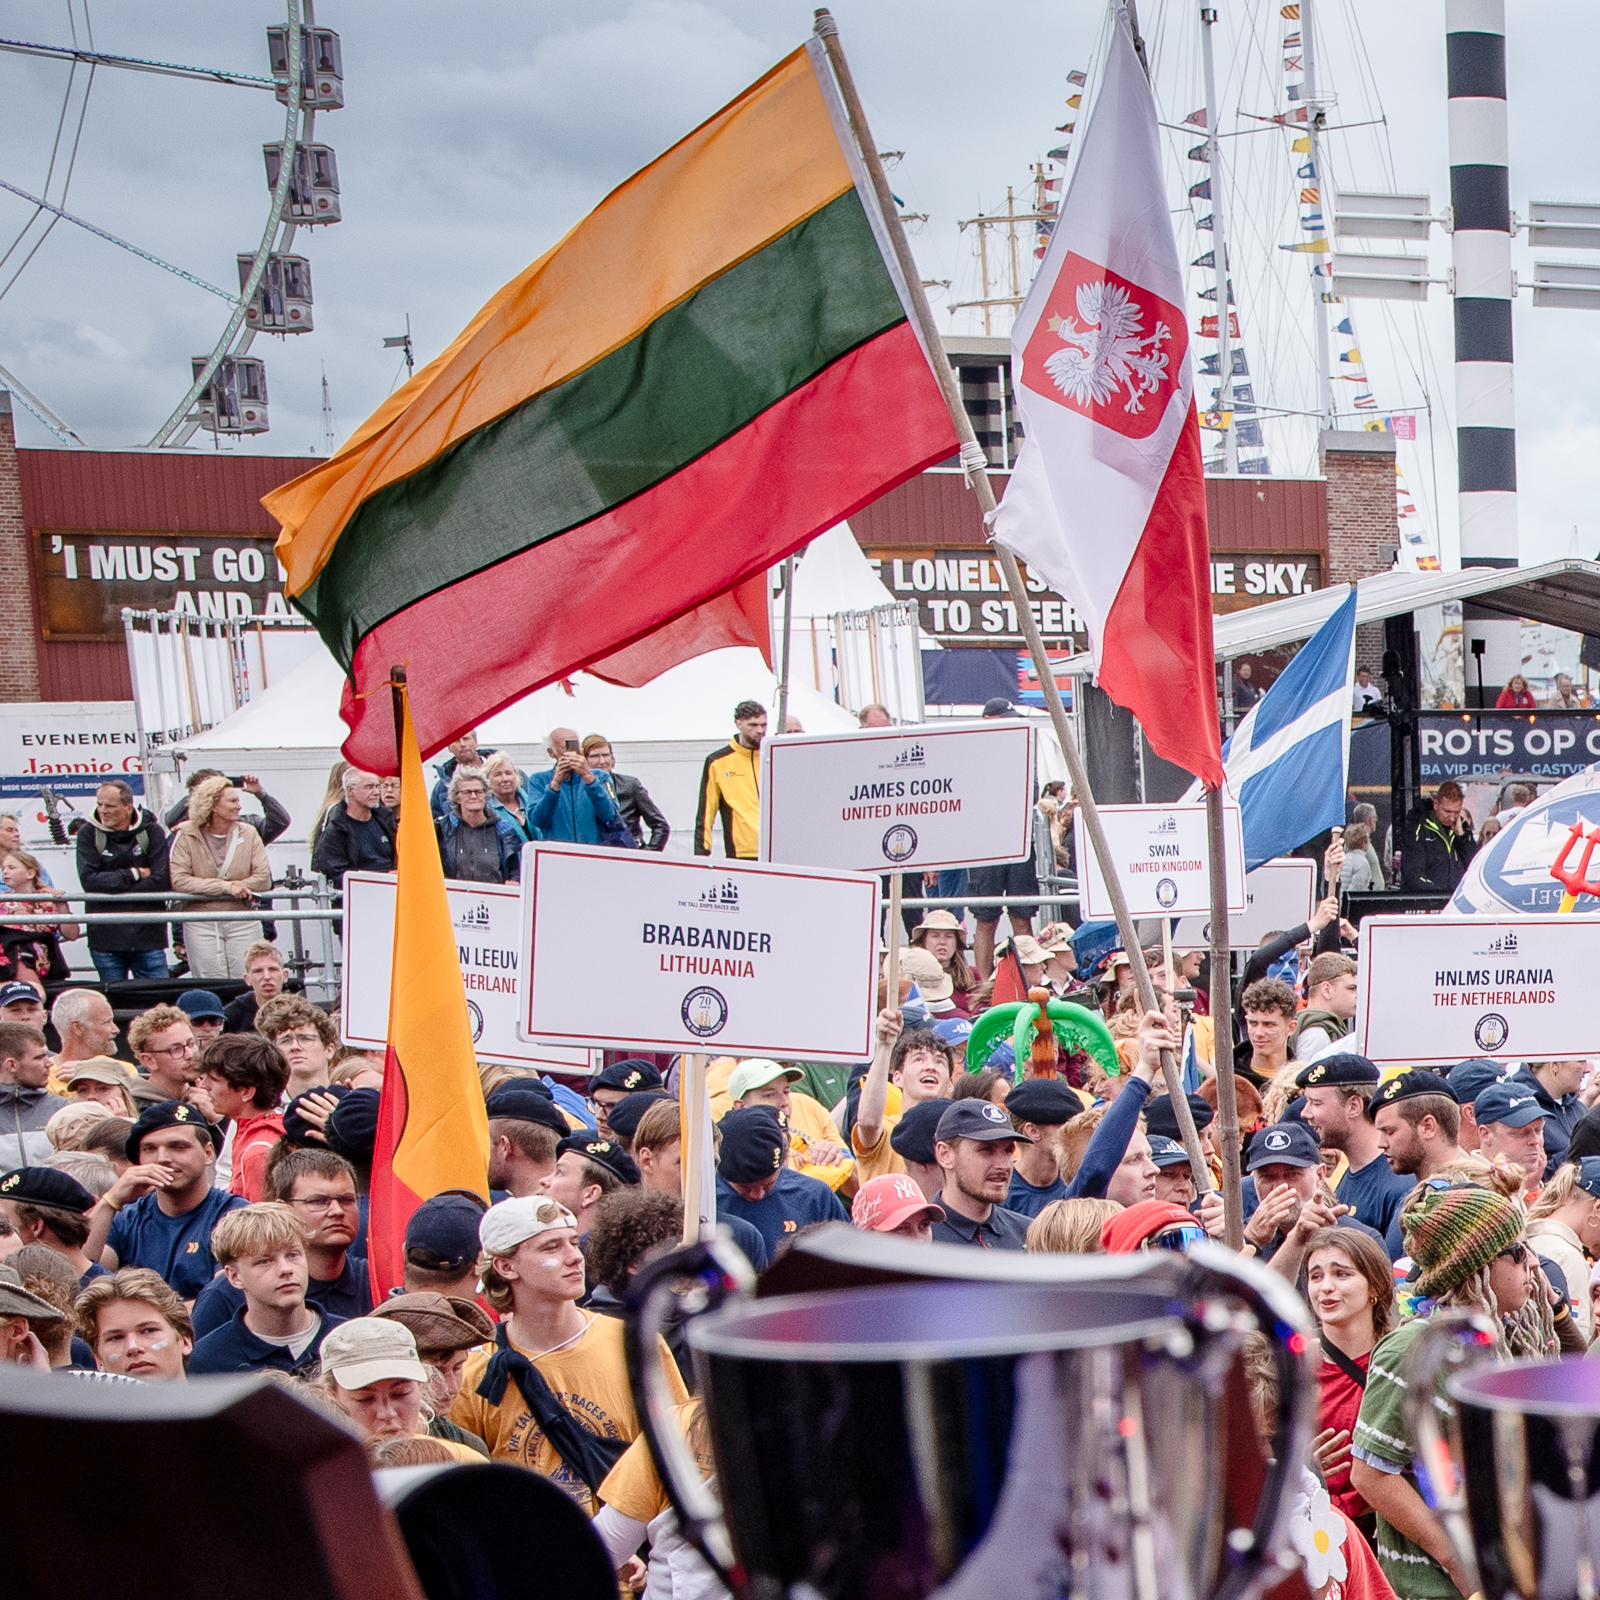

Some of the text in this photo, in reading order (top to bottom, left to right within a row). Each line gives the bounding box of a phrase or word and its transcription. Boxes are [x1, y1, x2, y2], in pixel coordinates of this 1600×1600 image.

[89, 545, 200, 582] MUST
[212, 547, 265, 582] GO
[927, 600, 1086, 633] TO STEER
[22, 732, 137, 746] EVENEMEN
[1421, 729, 1515, 756] ROTS
[1524, 730, 1576, 756] OP
[1444, 764, 1468, 776] VIP
[849, 777, 953, 801] JAMES COOK
[842, 799, 962, 821] UNITED KINGDOM
[1149, 844, 1180, 858] SWAN
[1129, 860, 1202, 874] UNITED KINGDOM
[642, 922, 772, 953] BRABANDER
[659, 954, 756, 979] LITHUANIA
[1435, 968, 1554, 986] HNLMS URANIA
[699, 996, 712, 1006] 70
[1433, 990, 1556, 1006] THE NETHERLANDS
[571, 1392, 607, 1421] RACES
[514, 1411, 534, 1433] TAL
[508, 1433, 521, 1454] THE
